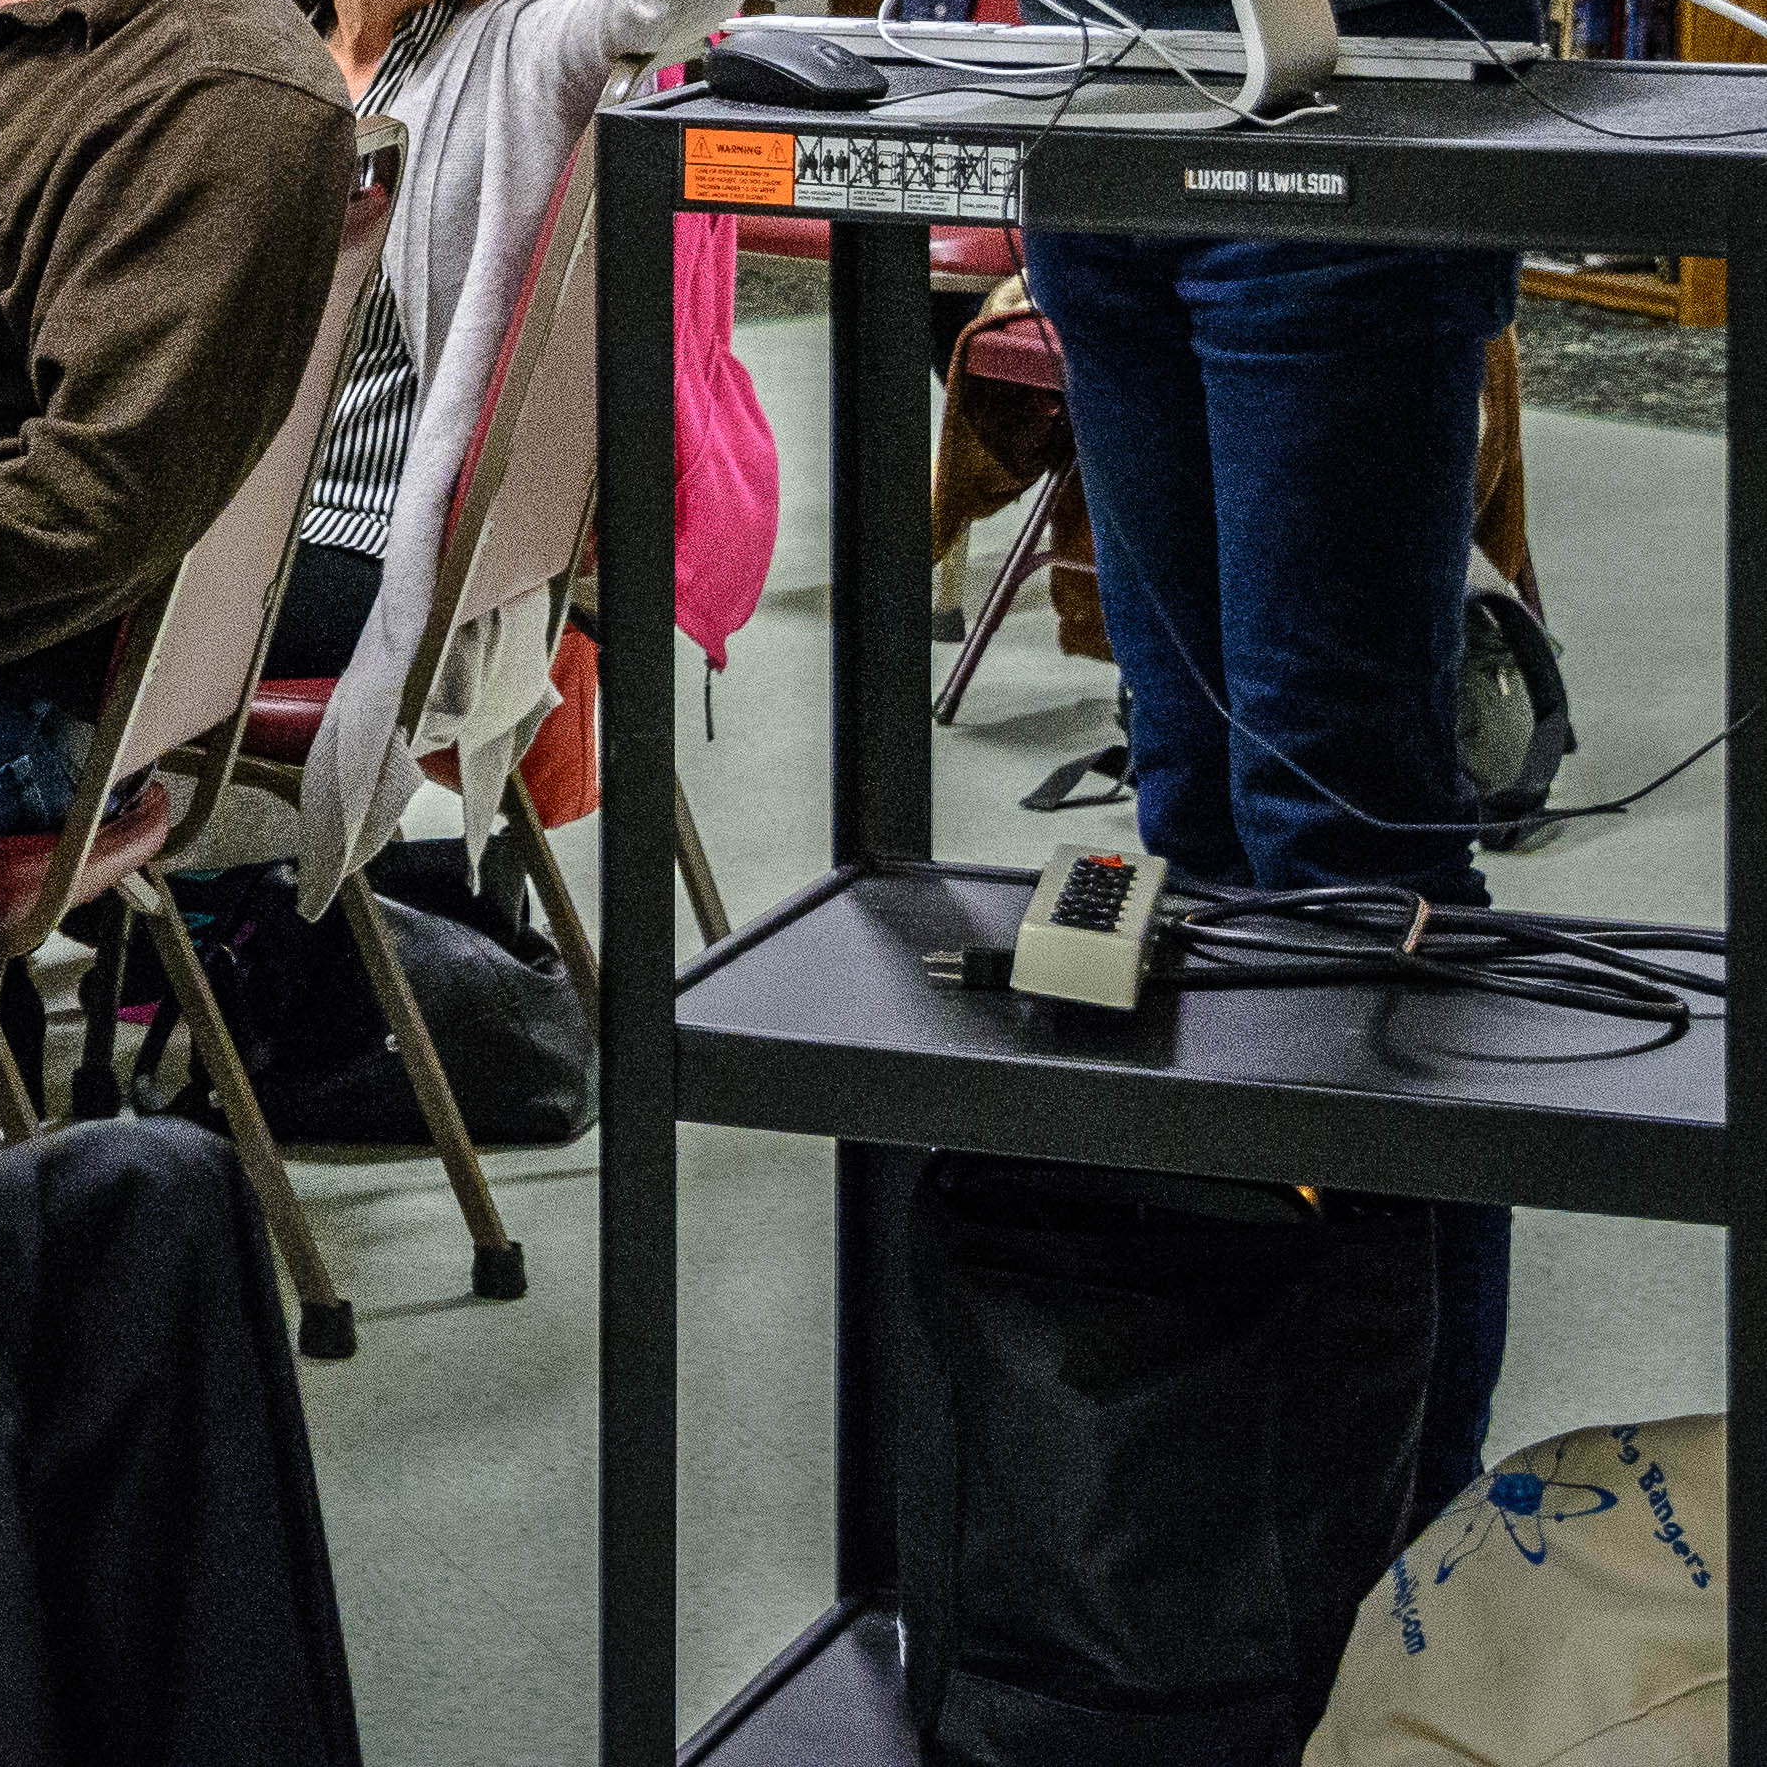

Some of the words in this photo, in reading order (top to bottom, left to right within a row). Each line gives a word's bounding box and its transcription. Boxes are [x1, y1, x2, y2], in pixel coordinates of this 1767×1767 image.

[715, 143, 763, 156] WARNING
[1184, 169, 1247, 191] LUXOR
[1638, 1461, 1711, 1589] Bangers
